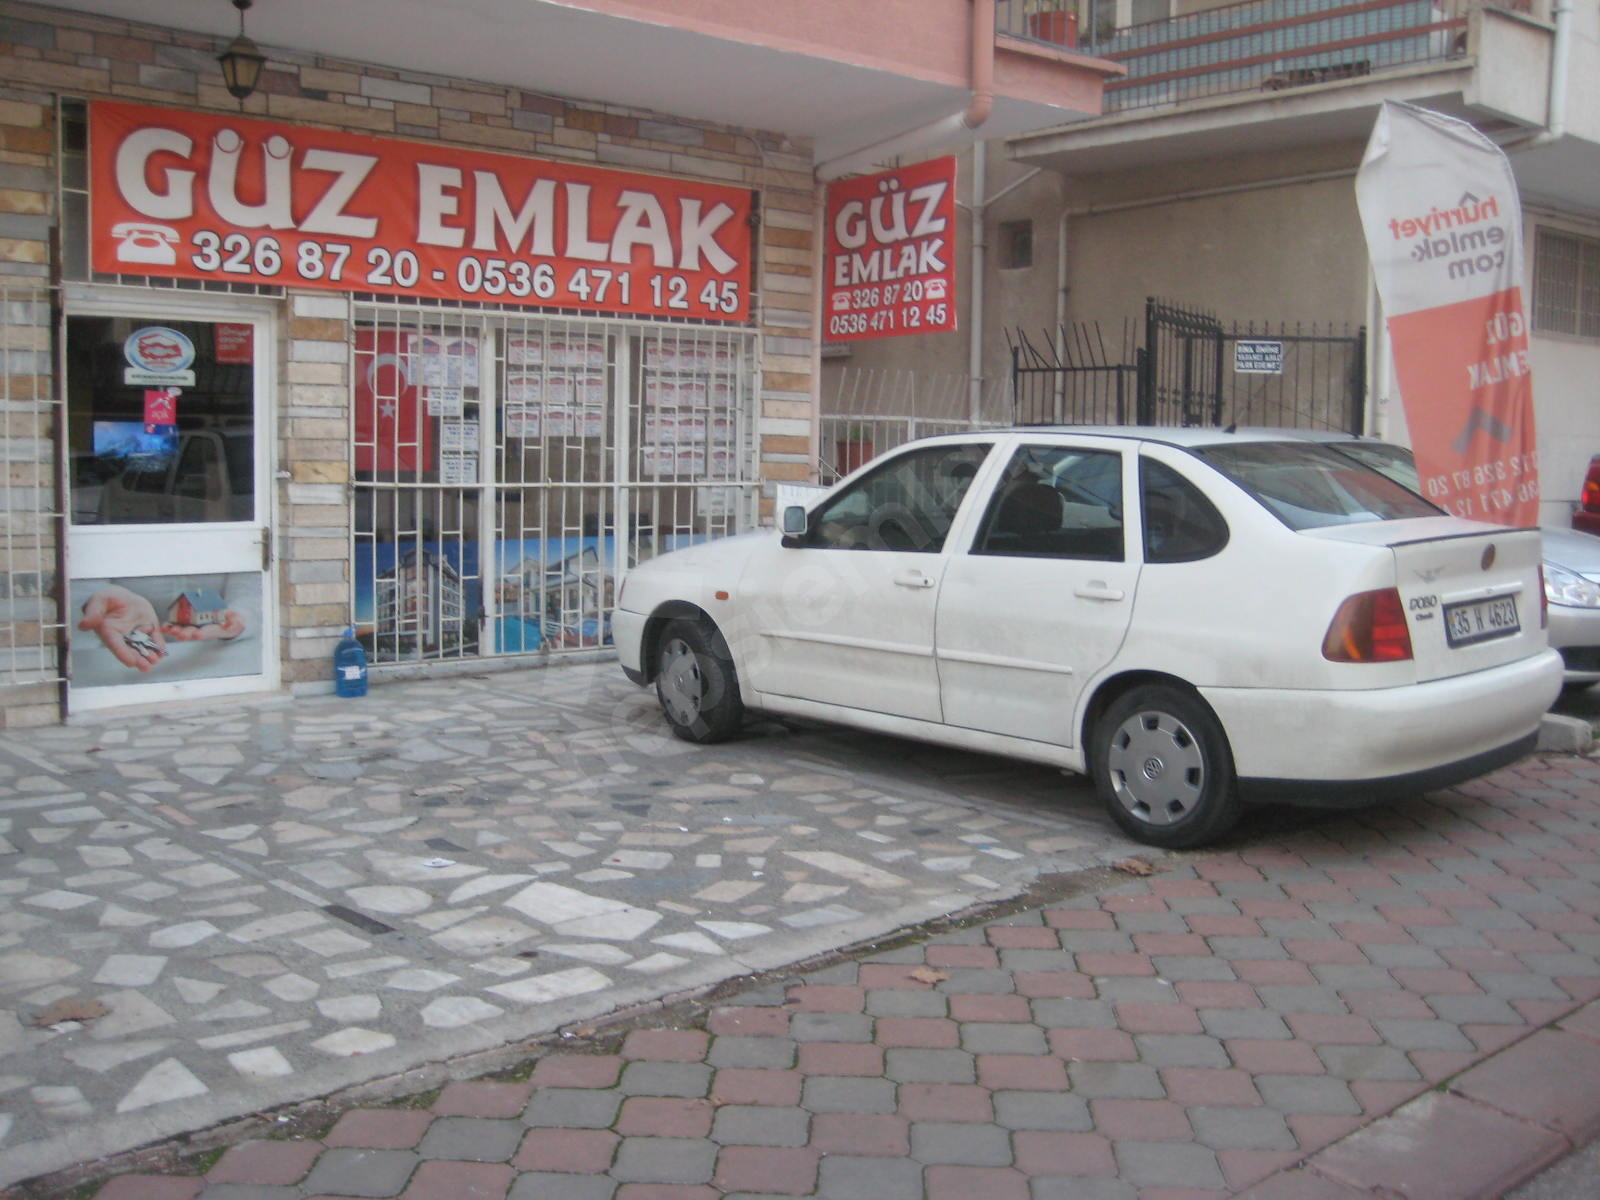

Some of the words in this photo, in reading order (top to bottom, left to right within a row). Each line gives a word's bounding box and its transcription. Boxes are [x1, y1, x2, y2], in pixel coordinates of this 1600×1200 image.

[116, 127, 379, 239] GÜZ
[415, 162, 739, 275] EMLAK
[835, 179, 947, 248] GÜZ
[191, 230, 282, 276] 326
[296, 240, 351, 281] 87
[366, 247, 420, 287] 20
[457, 256, 556, 299] 0536
[568, 267, 632, 305] 471
[650, 274, 689, 310] 12
[700, 280, 739, 314] 45
[834, 238, 947, 287] EMLAK
[830, 314, 867, 335] 0536
[870, 309, 894, 332] 471
[902, 307, 921, 328] 12
[925, 303, 947, 325] 45
[852, 287, 880, 309] 326
[883, 284, 900, 305] 87
[903, 280, 923, 302] 20
[1455, 610, 1471, 634] 35
[1488, 602, 1514, 627] 4623
